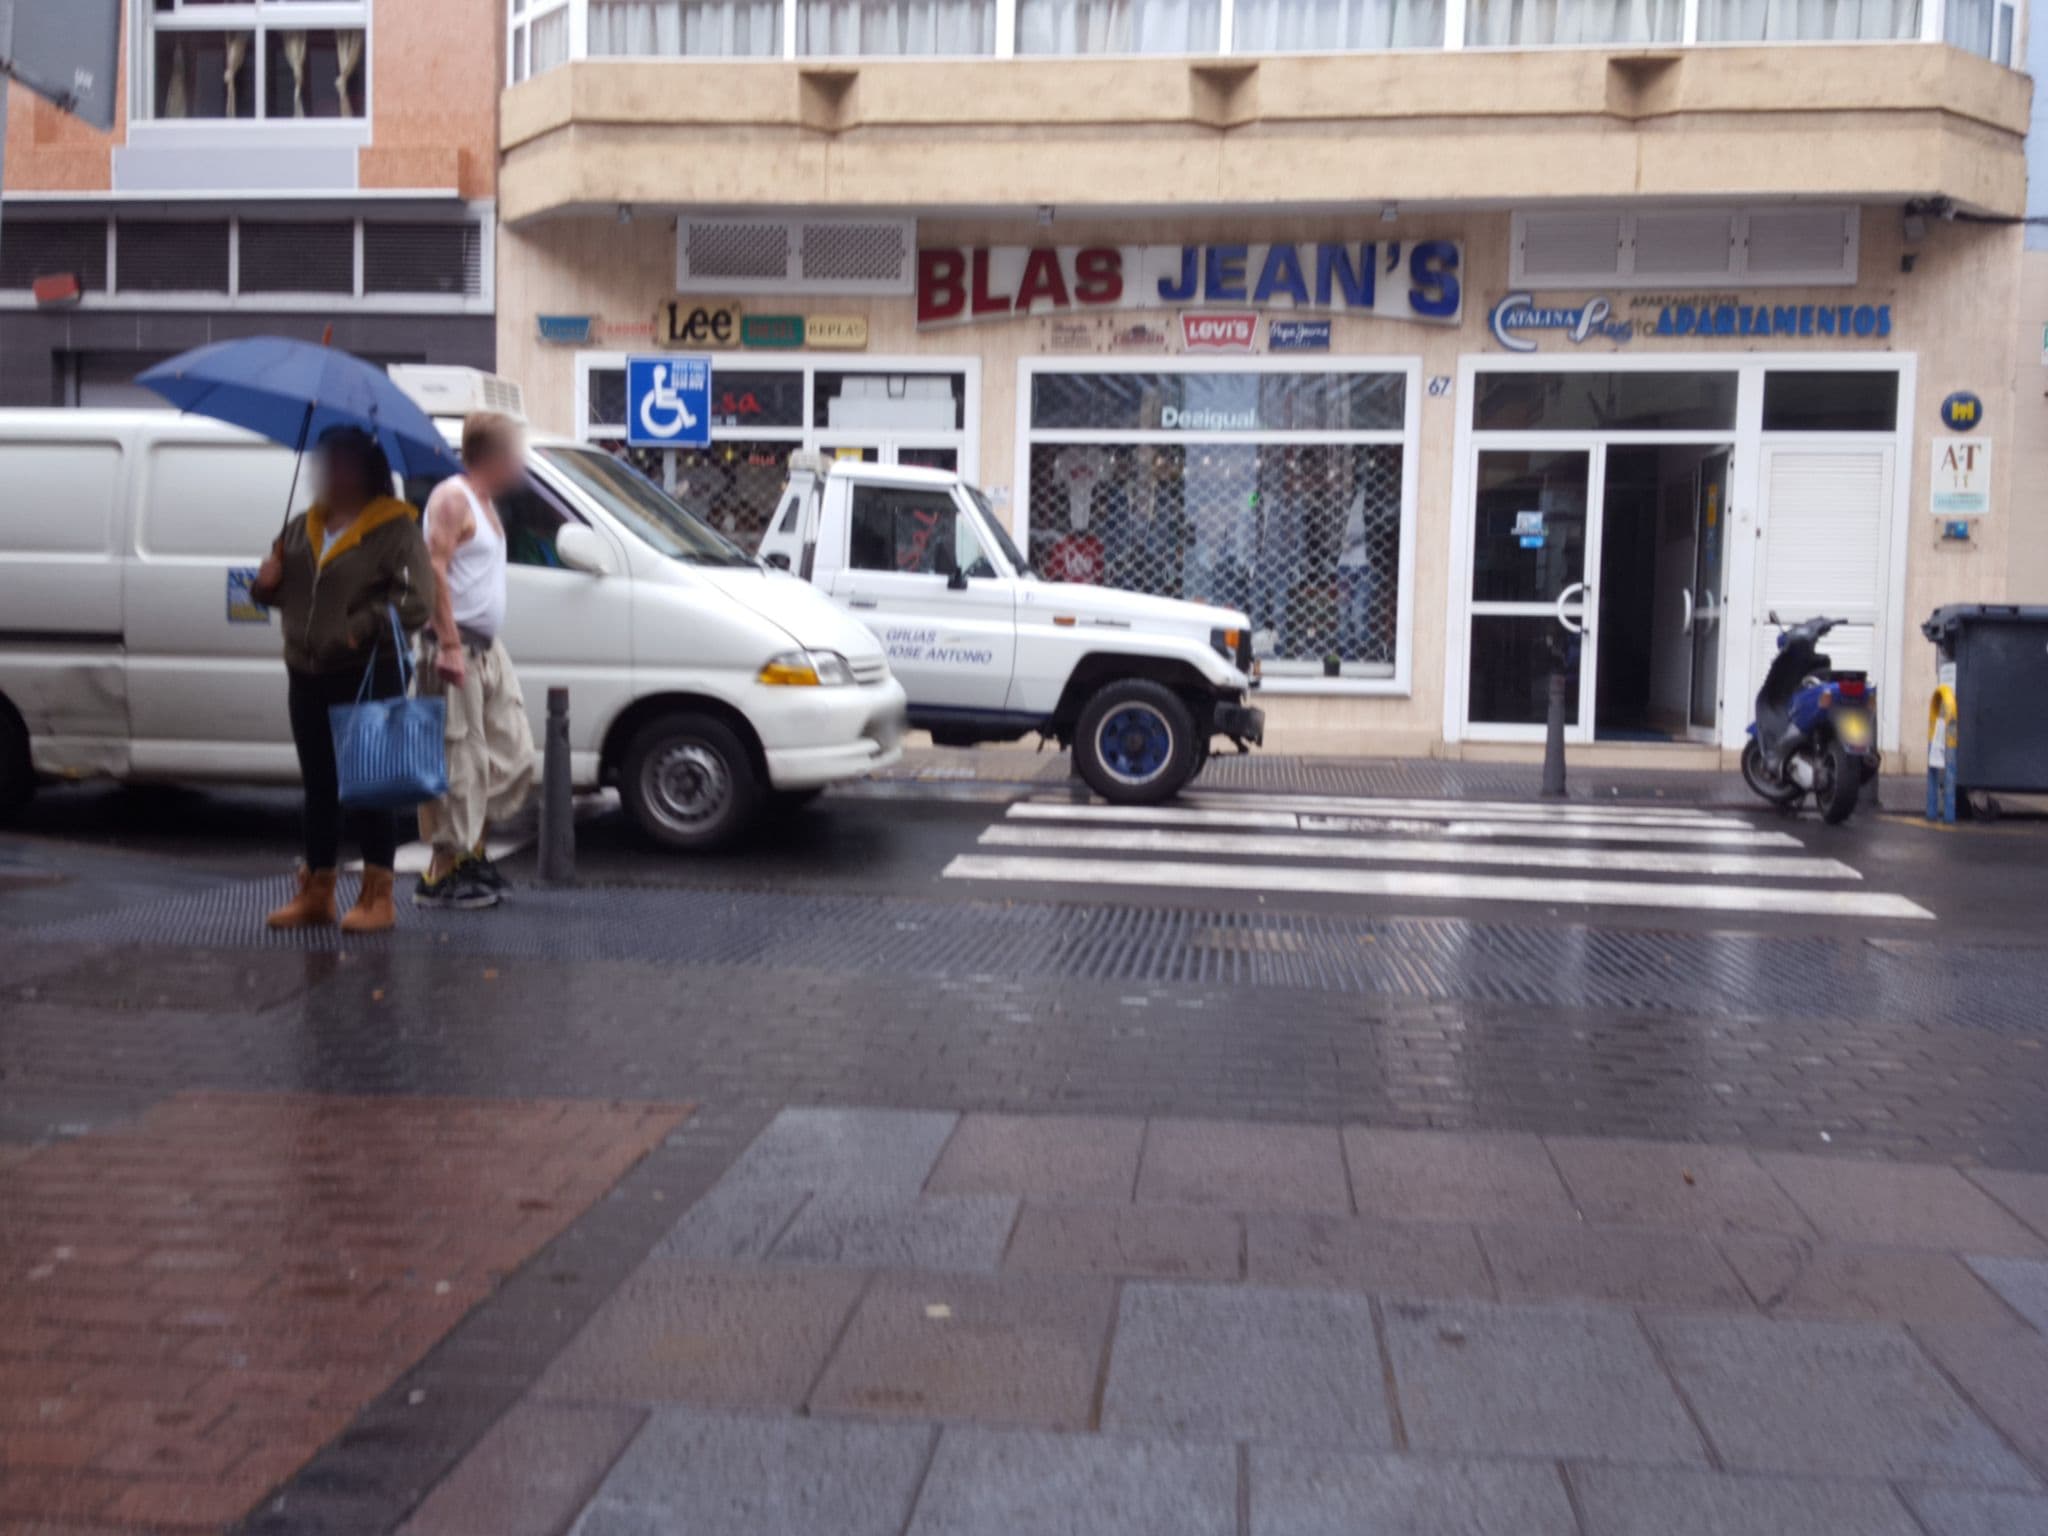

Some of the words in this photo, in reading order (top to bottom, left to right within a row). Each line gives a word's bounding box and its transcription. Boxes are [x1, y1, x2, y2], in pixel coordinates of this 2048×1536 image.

[917, 247, 1124, 323] BLAS
[1157, 240, 1459, 317] JEAN'S
[667, 301, 732, 342] Lee
[1655, 304, 1892, 338] APARTAMENTOS
[1428, 375, 1451, 396] 67
[1161, 406, 1255, 430] Desigual
[924, 648, 993, 665] ANTONIO
